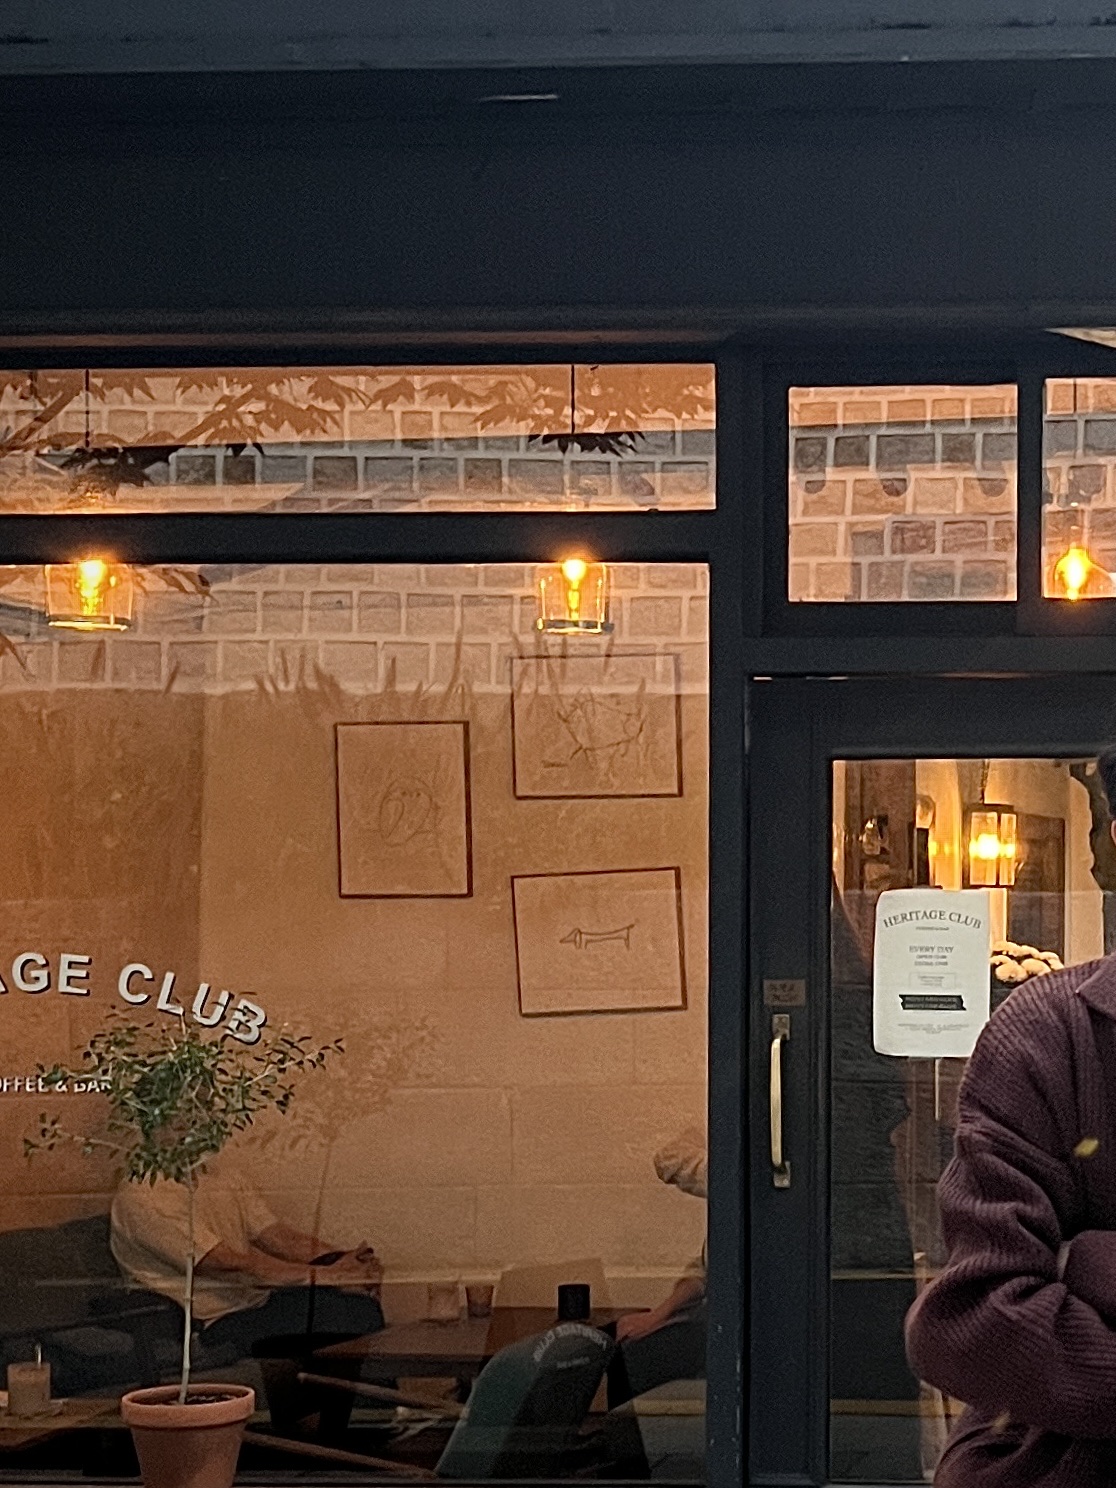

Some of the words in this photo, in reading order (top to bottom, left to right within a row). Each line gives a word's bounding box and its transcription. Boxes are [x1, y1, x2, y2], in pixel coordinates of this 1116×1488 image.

[883, 910, 946, 928] HERITAGE
[948, 912, 982, 929] CLUB
[0, 952, 91, 994] GE
[118, 963, 267, 1044] CLUB
[0, 1077, 48, 1092] FFEE
